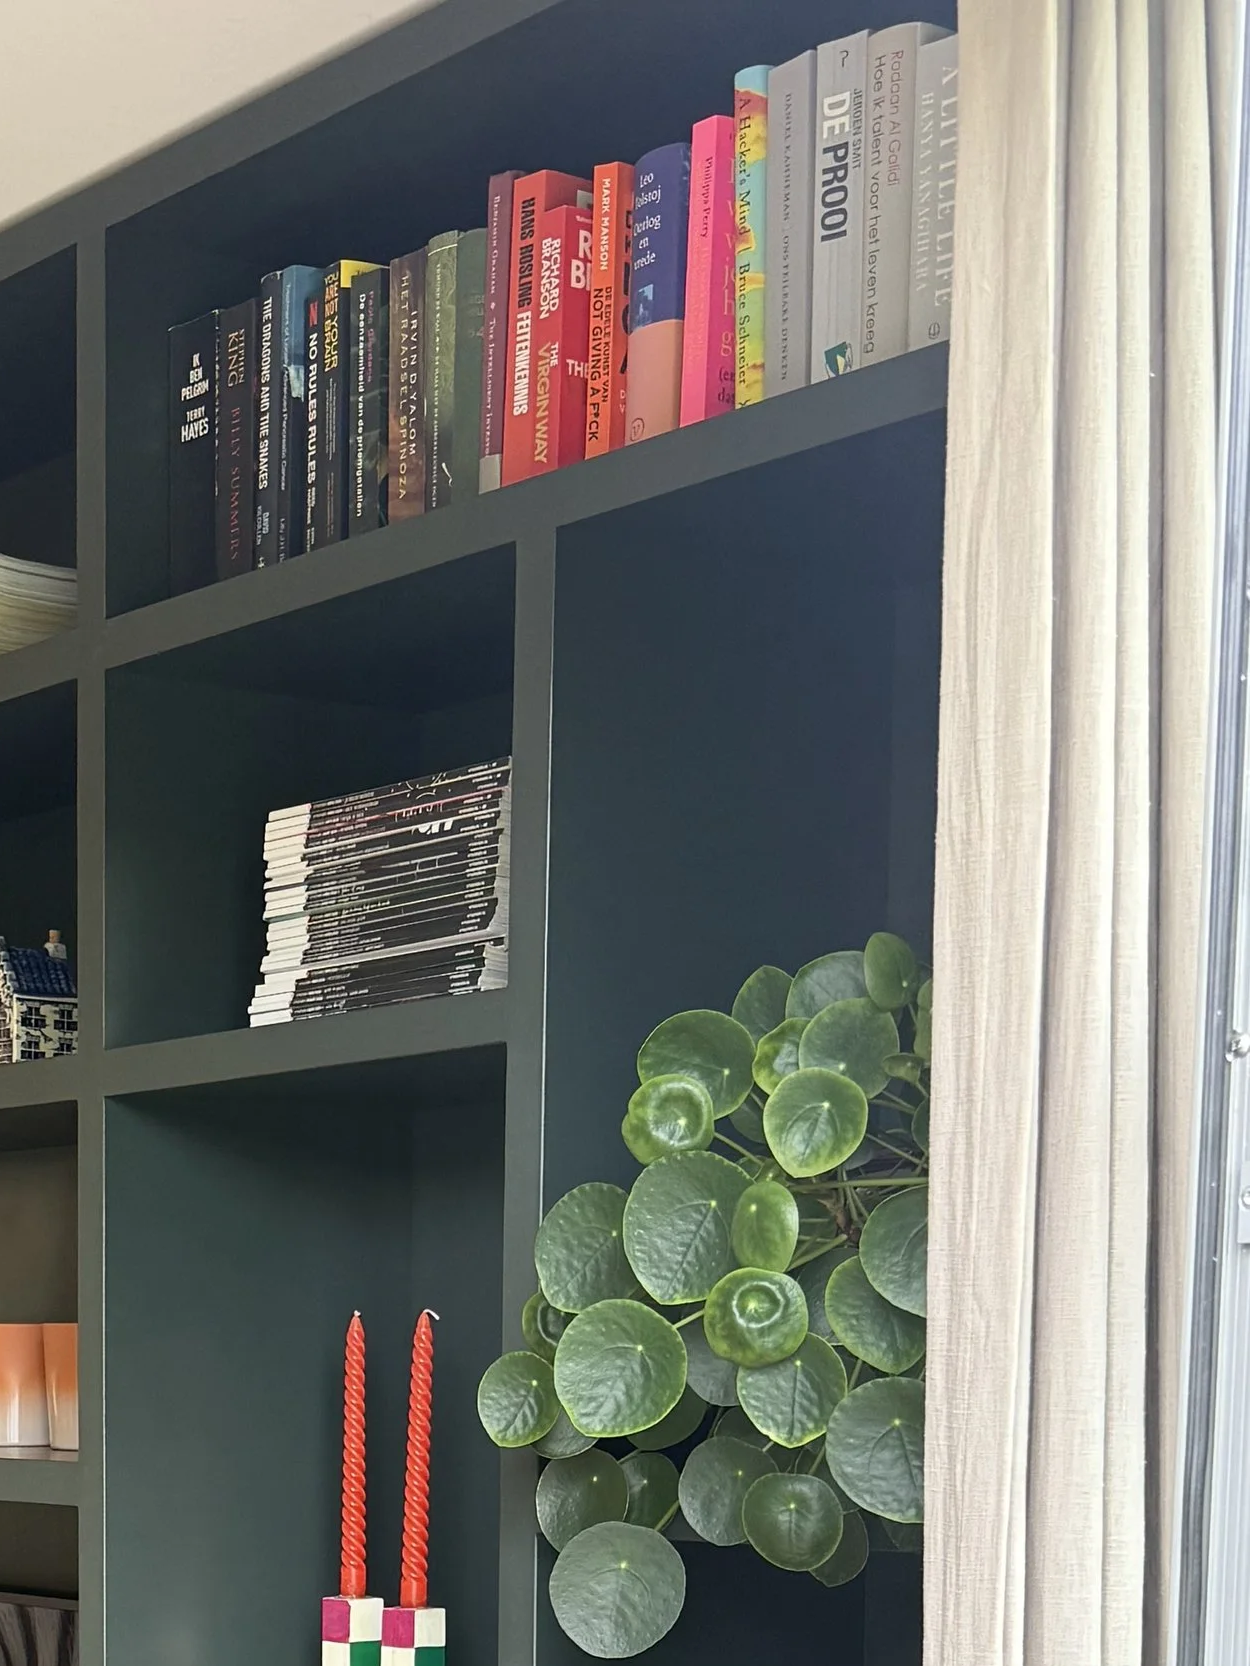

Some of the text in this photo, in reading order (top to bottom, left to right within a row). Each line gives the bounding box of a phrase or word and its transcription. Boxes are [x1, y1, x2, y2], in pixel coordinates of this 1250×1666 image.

[852, 88, 863, 170] JEROEN SMIT
[889, 120, 901, 136] Al
[919, 92, 934, 159] HANYA
[640, 172, 654, 188] Leo
[821, 91, 850, 243] DE PROOI
[887, 139, 901, 186] Galidi
[600, 178, 610, 271] MARK MANSON
[700, 156, 714, 239] Philippa Perry
[863, 54, 886, 354] Hoe ik talent voor het leven kreeg
[634, 250, 656, 271] vrede
[638, 236, 649, 250] en
[738, 98, 751, 386] A Hacker's Mind Bruce Schneier
[324, 271, 339, 286] YOU
[358, 294, 366, 310] De
[539, 237, 552, 320] BRANSON
[549, 238, 561, 312] RICHARD
[513, 197, 536, 417] HANS ROSLING FEITENKENNIS
[593, 288, 604, 322] NOT
[192, 352, 200, 368] IK
[227, 332, 240, 388] KING
[308, 332, 318, 360] NO
[330, 316, 338, 369] YOUR
[410, 310, 418, 366] IRVIN
[550, 342, 558, 367] THE
[590, 326, 602, 382] GIVING
[601, 286, 612, 403] DE EDELE KUNST VAN
[181, 380, 210, 402] PELGRIM
[190, 366, 203, 383] BEN
[258, 296, 272, 490] THE DRAGONS AND THE SNAKES
[308, 363, 318, 423] RULES
[398, 275, 410, 500] HET RAADSEL SPINOZA
[590, 387, 600, 398] A
[181, 418, 209, 443] HAYES
[186, 406, 205, 422] TERRY
[357, 419, 364, 434] de
[534, 342, 551, 464] VIRGIN WAY
[307, 424, 317, 484] RULES
[356, 436, 364, 518] priemgetallen
[230, 408, 241, 560] BILLY SUMMERS
